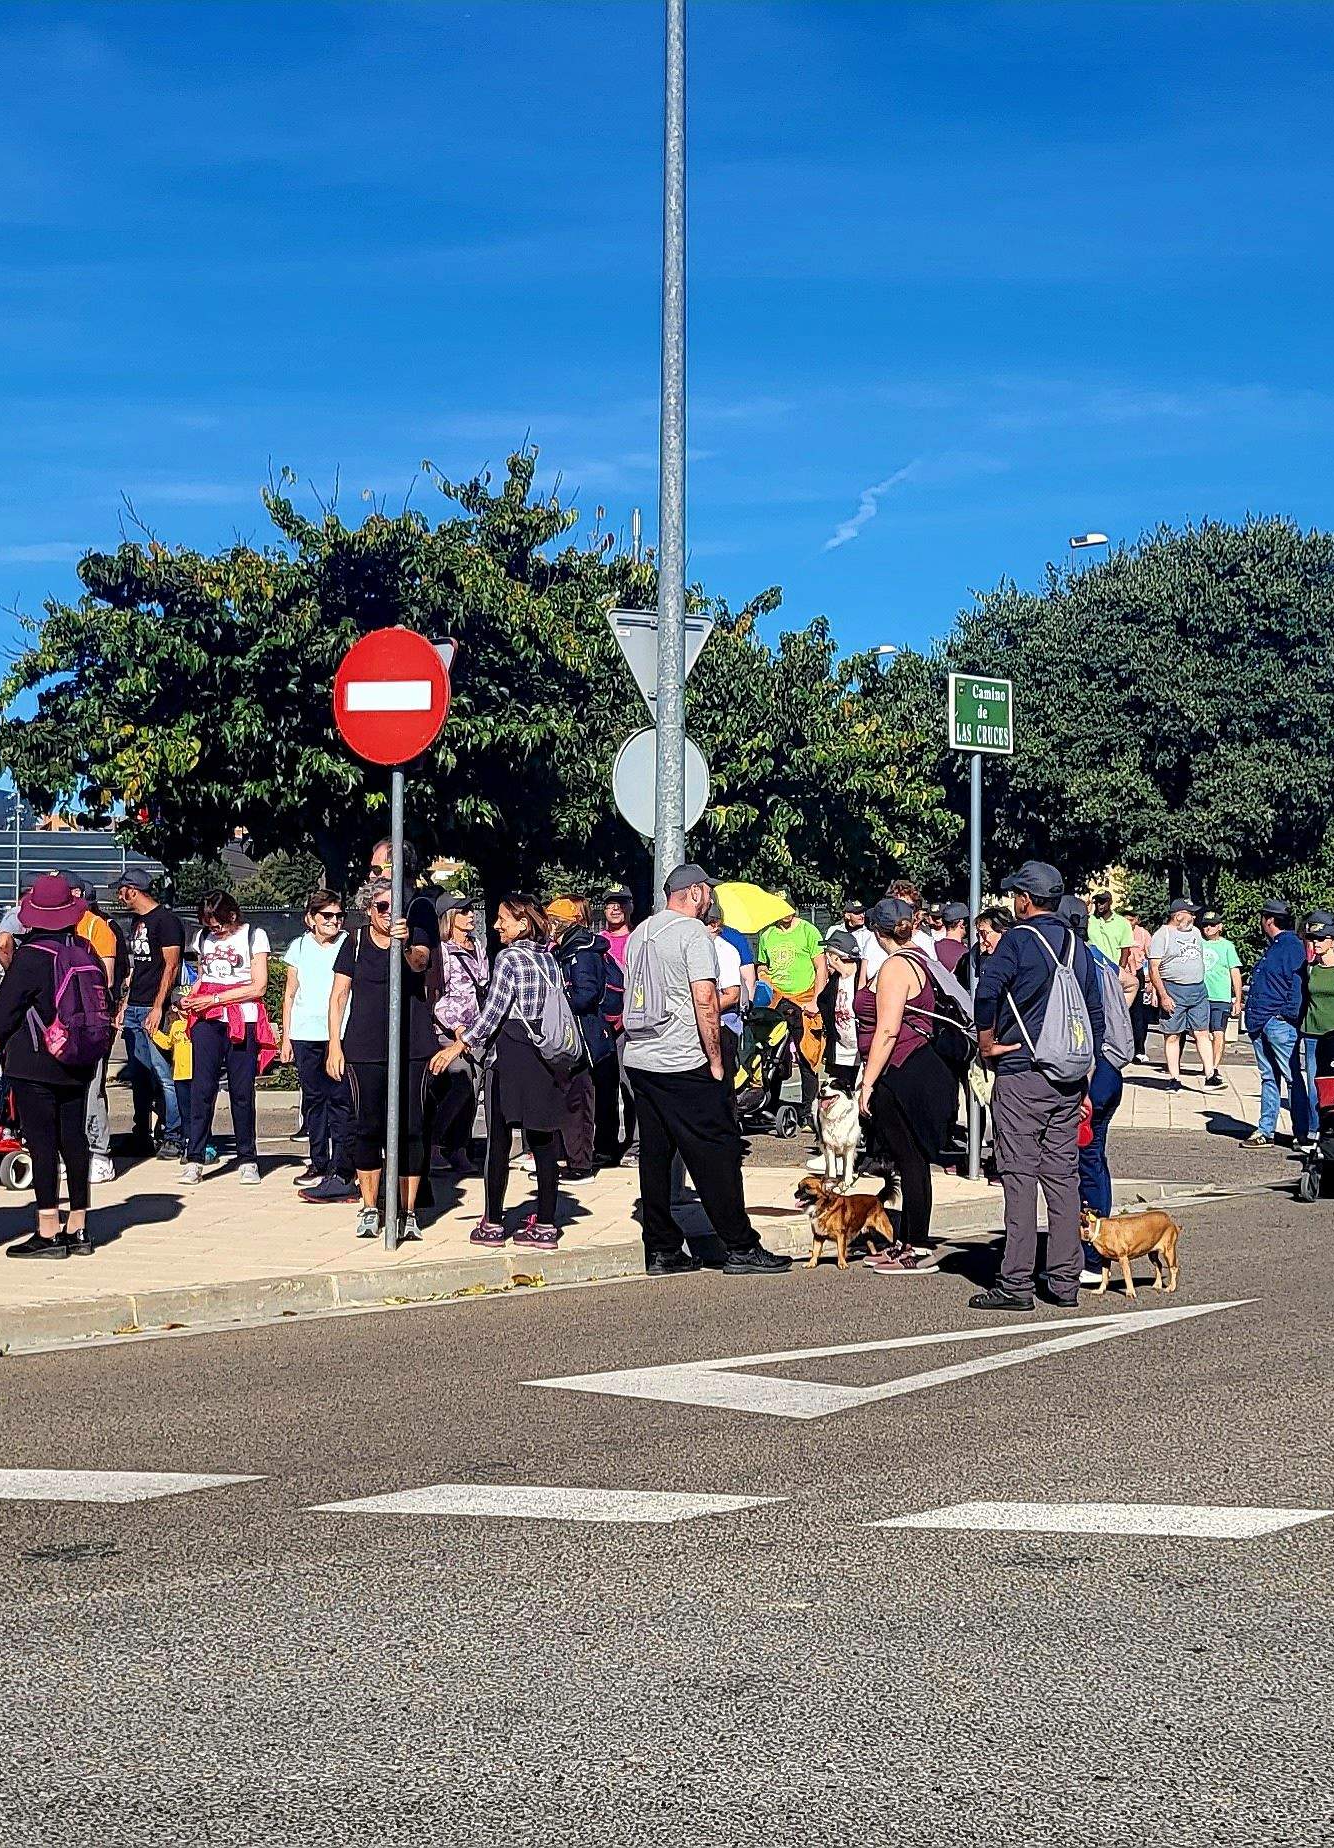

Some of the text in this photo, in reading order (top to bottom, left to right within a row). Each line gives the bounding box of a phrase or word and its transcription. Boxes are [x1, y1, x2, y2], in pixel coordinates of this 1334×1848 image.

[972, 684, 1006, 702] Camino
[977, 704, 988, 719] de
[956, 722, 1008, 746] LAS CRUCES
